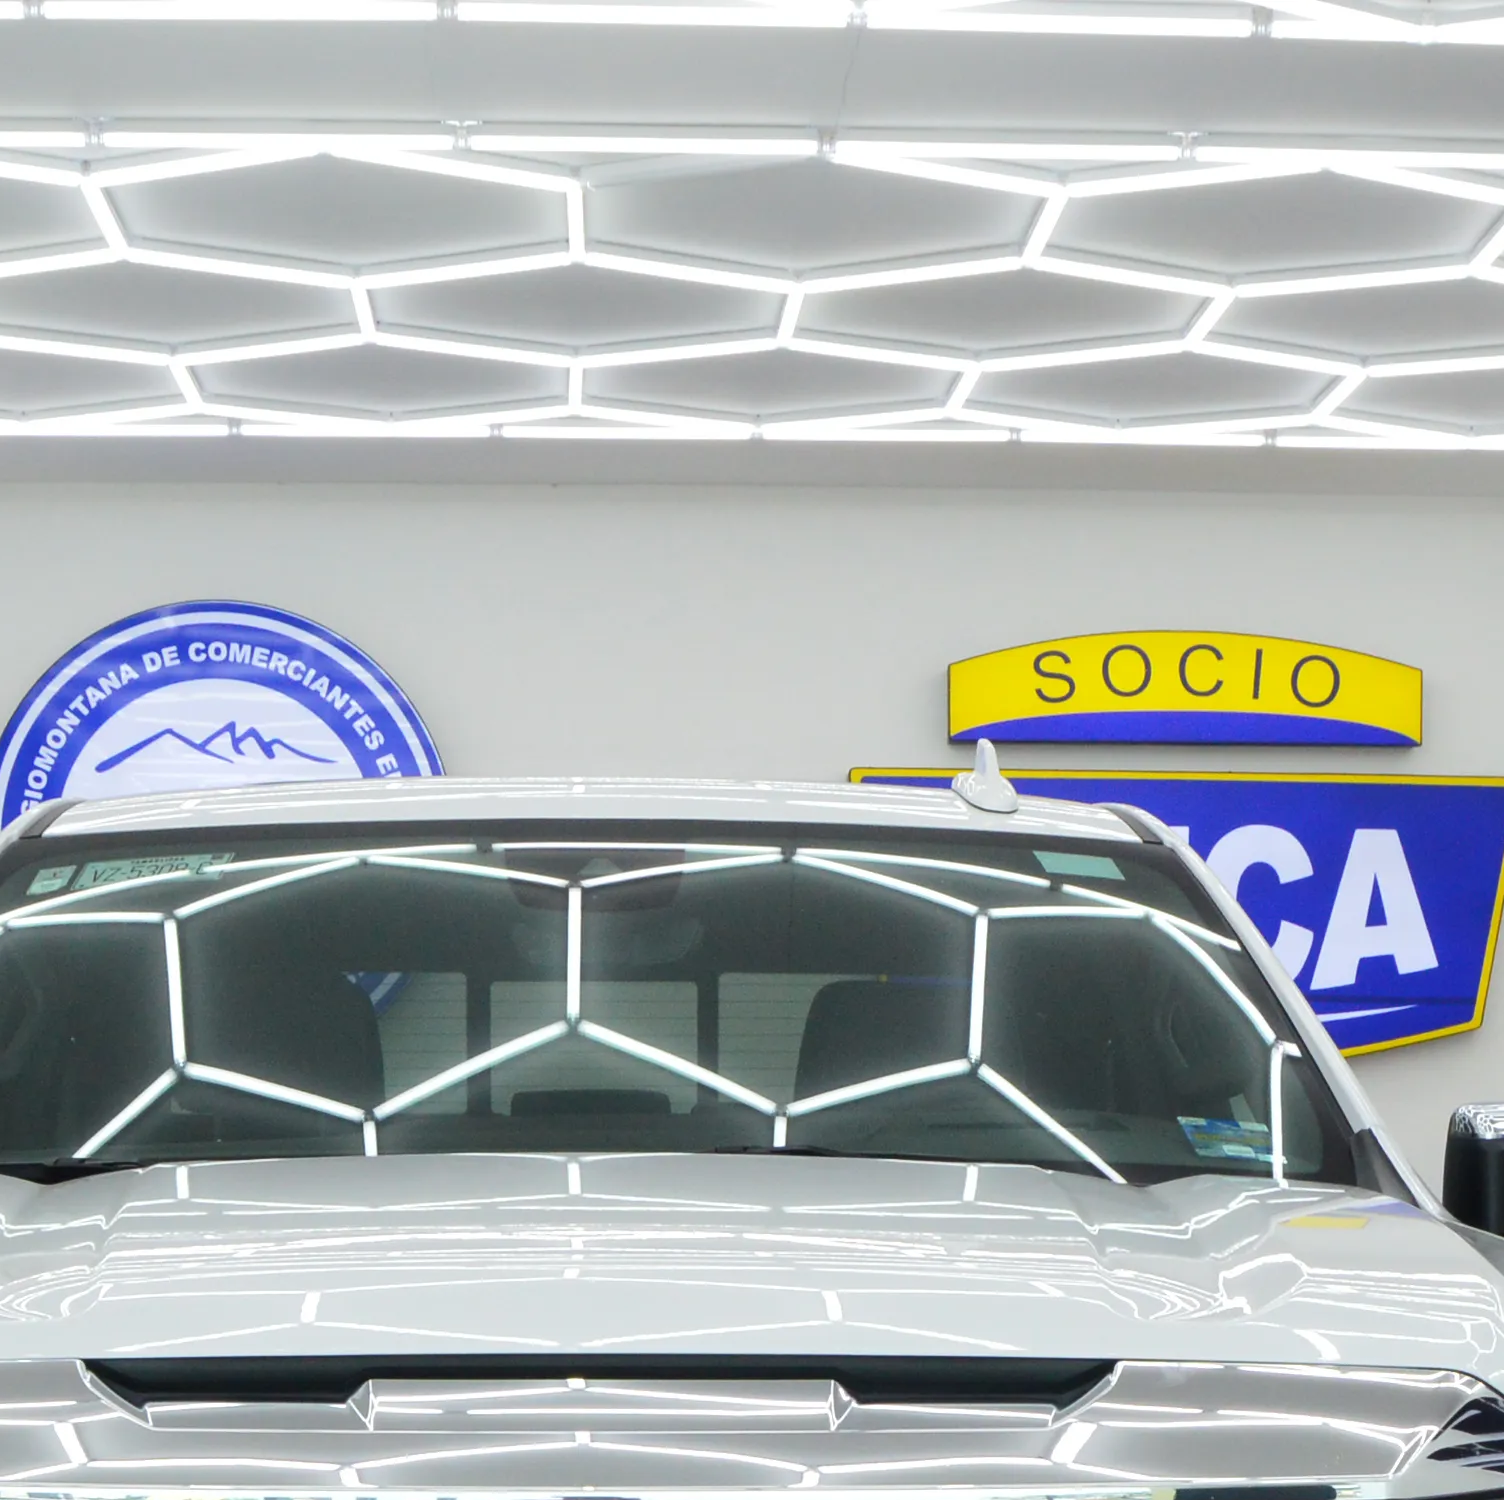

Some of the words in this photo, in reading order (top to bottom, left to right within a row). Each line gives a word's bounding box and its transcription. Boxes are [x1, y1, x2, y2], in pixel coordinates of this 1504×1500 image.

[142, 646, 180, 673] DE
[188, 641, 385, 750] COMERCIANTES
[1033, 644, 1341, 708] SOCIO
[1175, 824, 1440, 991] CA
